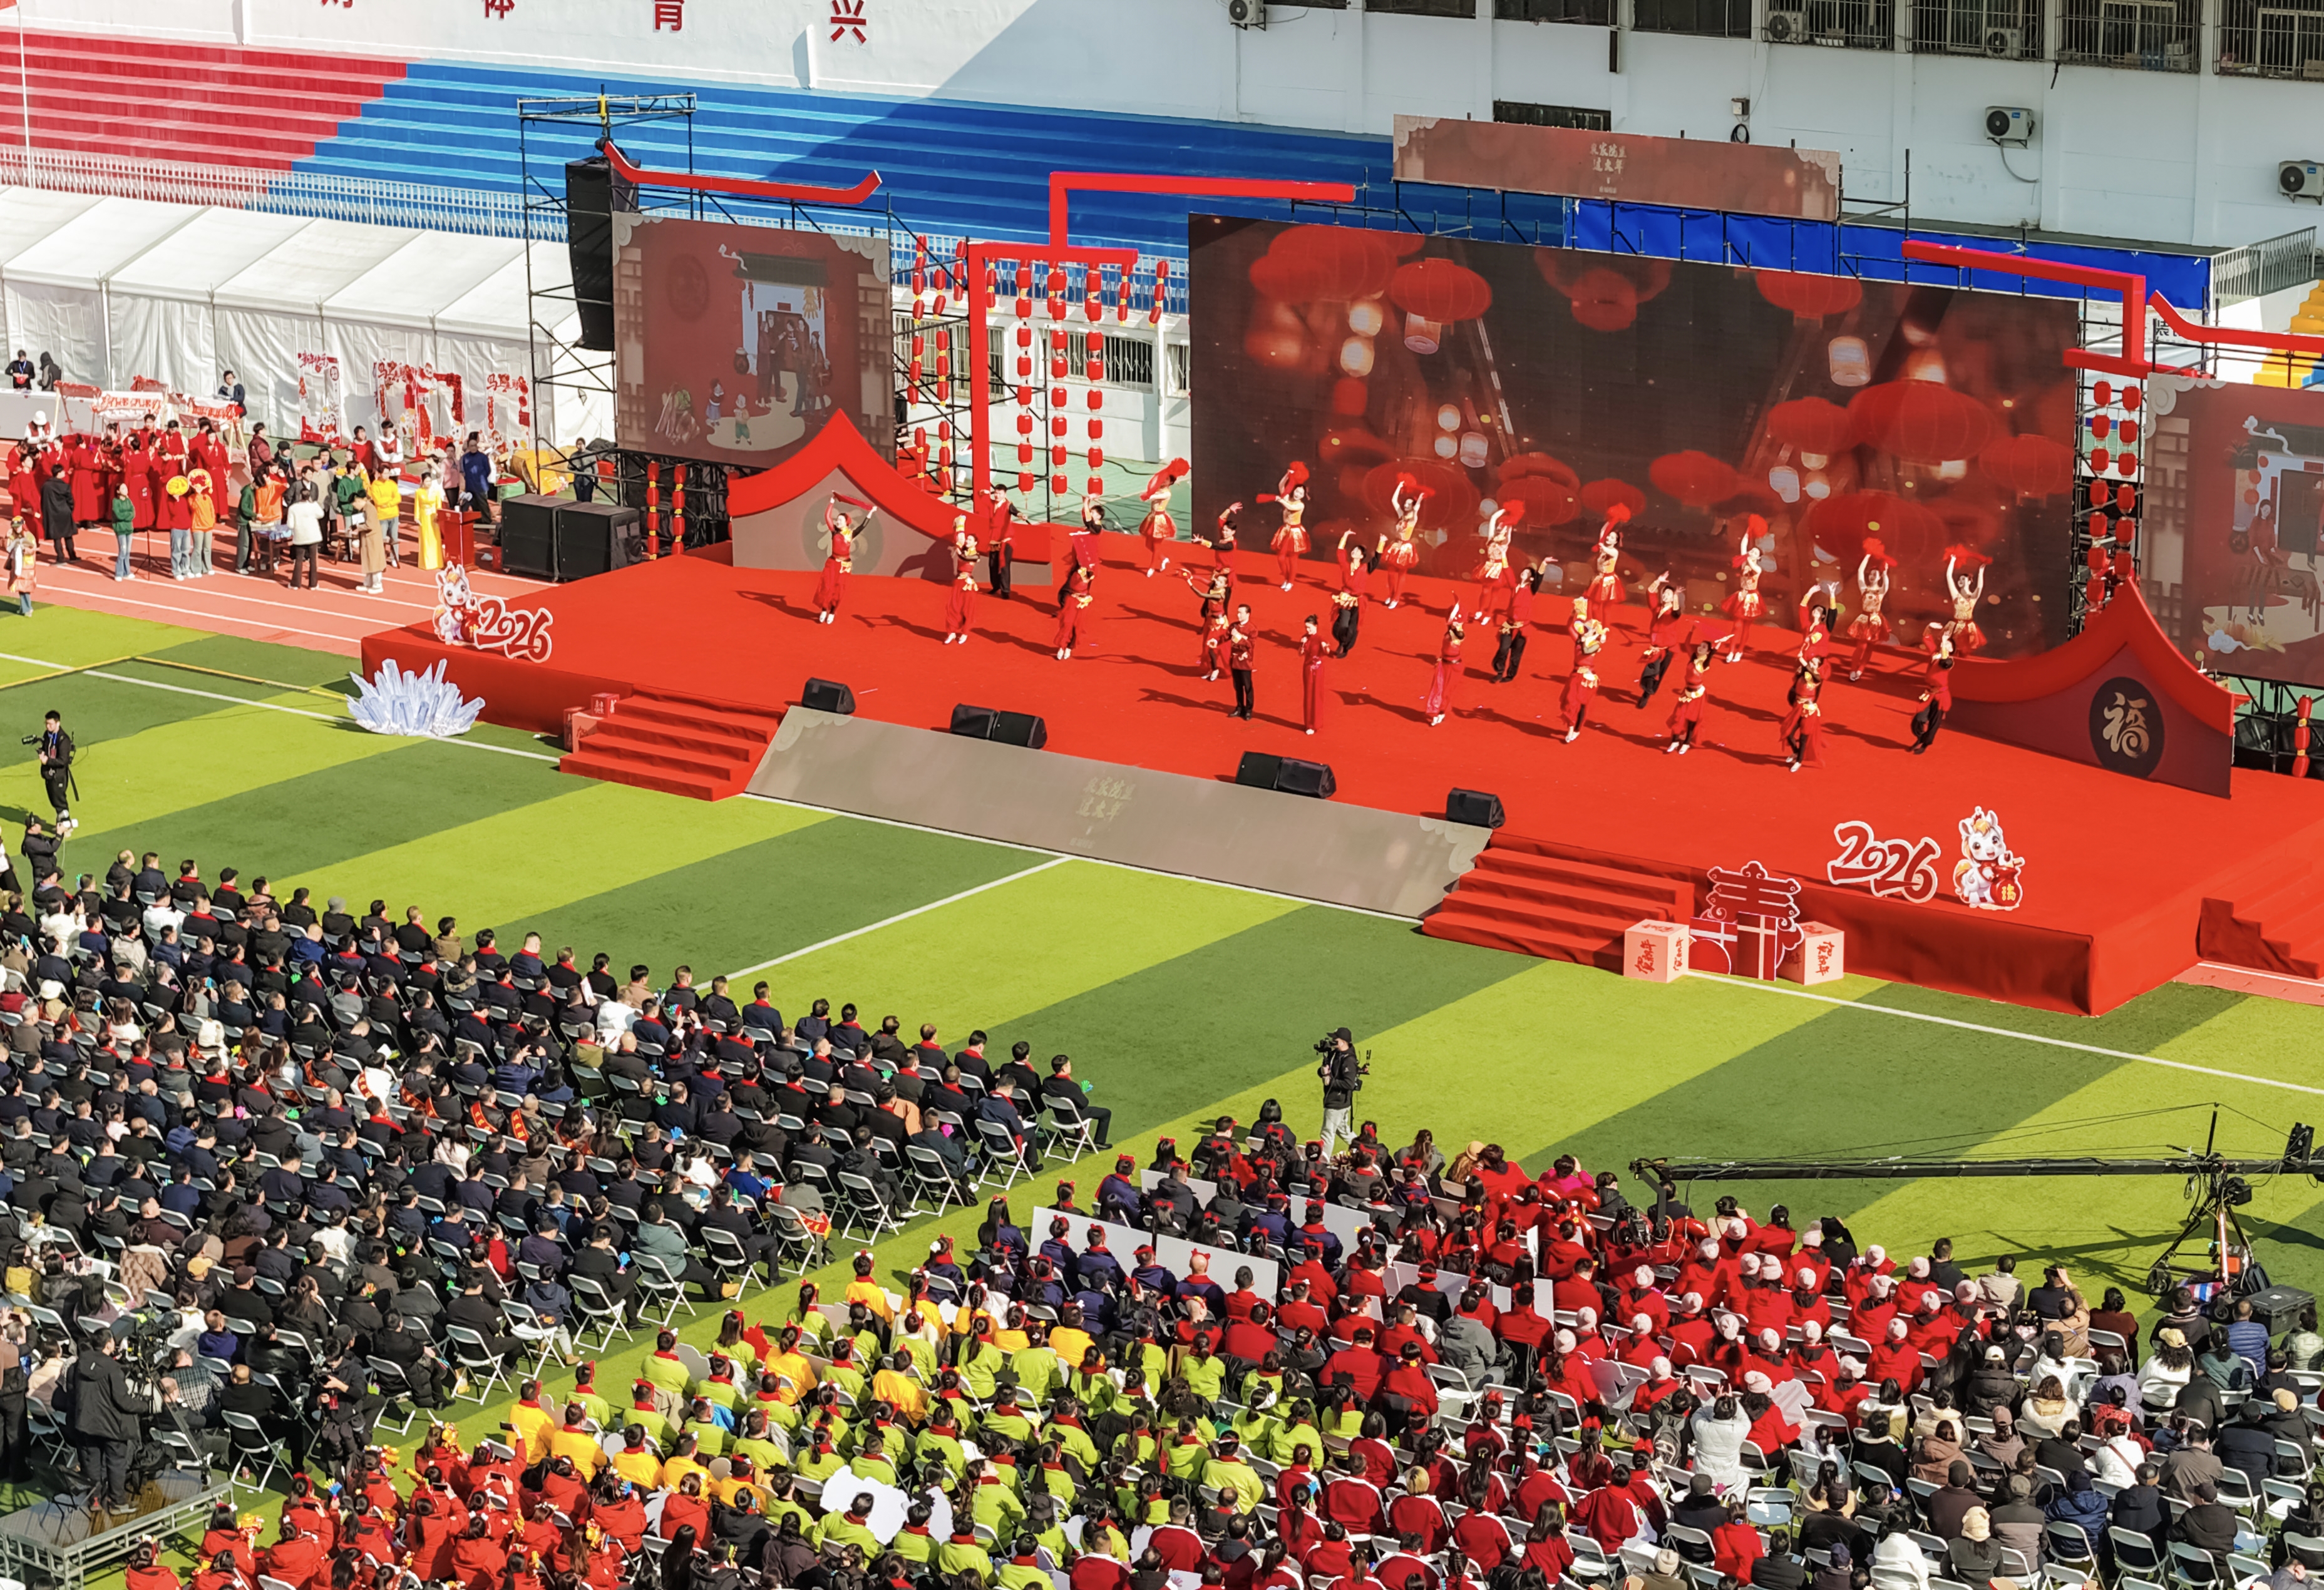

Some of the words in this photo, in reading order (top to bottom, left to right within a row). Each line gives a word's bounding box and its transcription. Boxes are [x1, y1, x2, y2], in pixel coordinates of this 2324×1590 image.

[475, 597, 553, 662] 2026
[2103, 692, 2149, 759] 福
[1828, 821, 1940, 903] 2026
[1634, 939, 1657, 975] 贺新年
[1815, 941, 1835, 976] 贺新年
